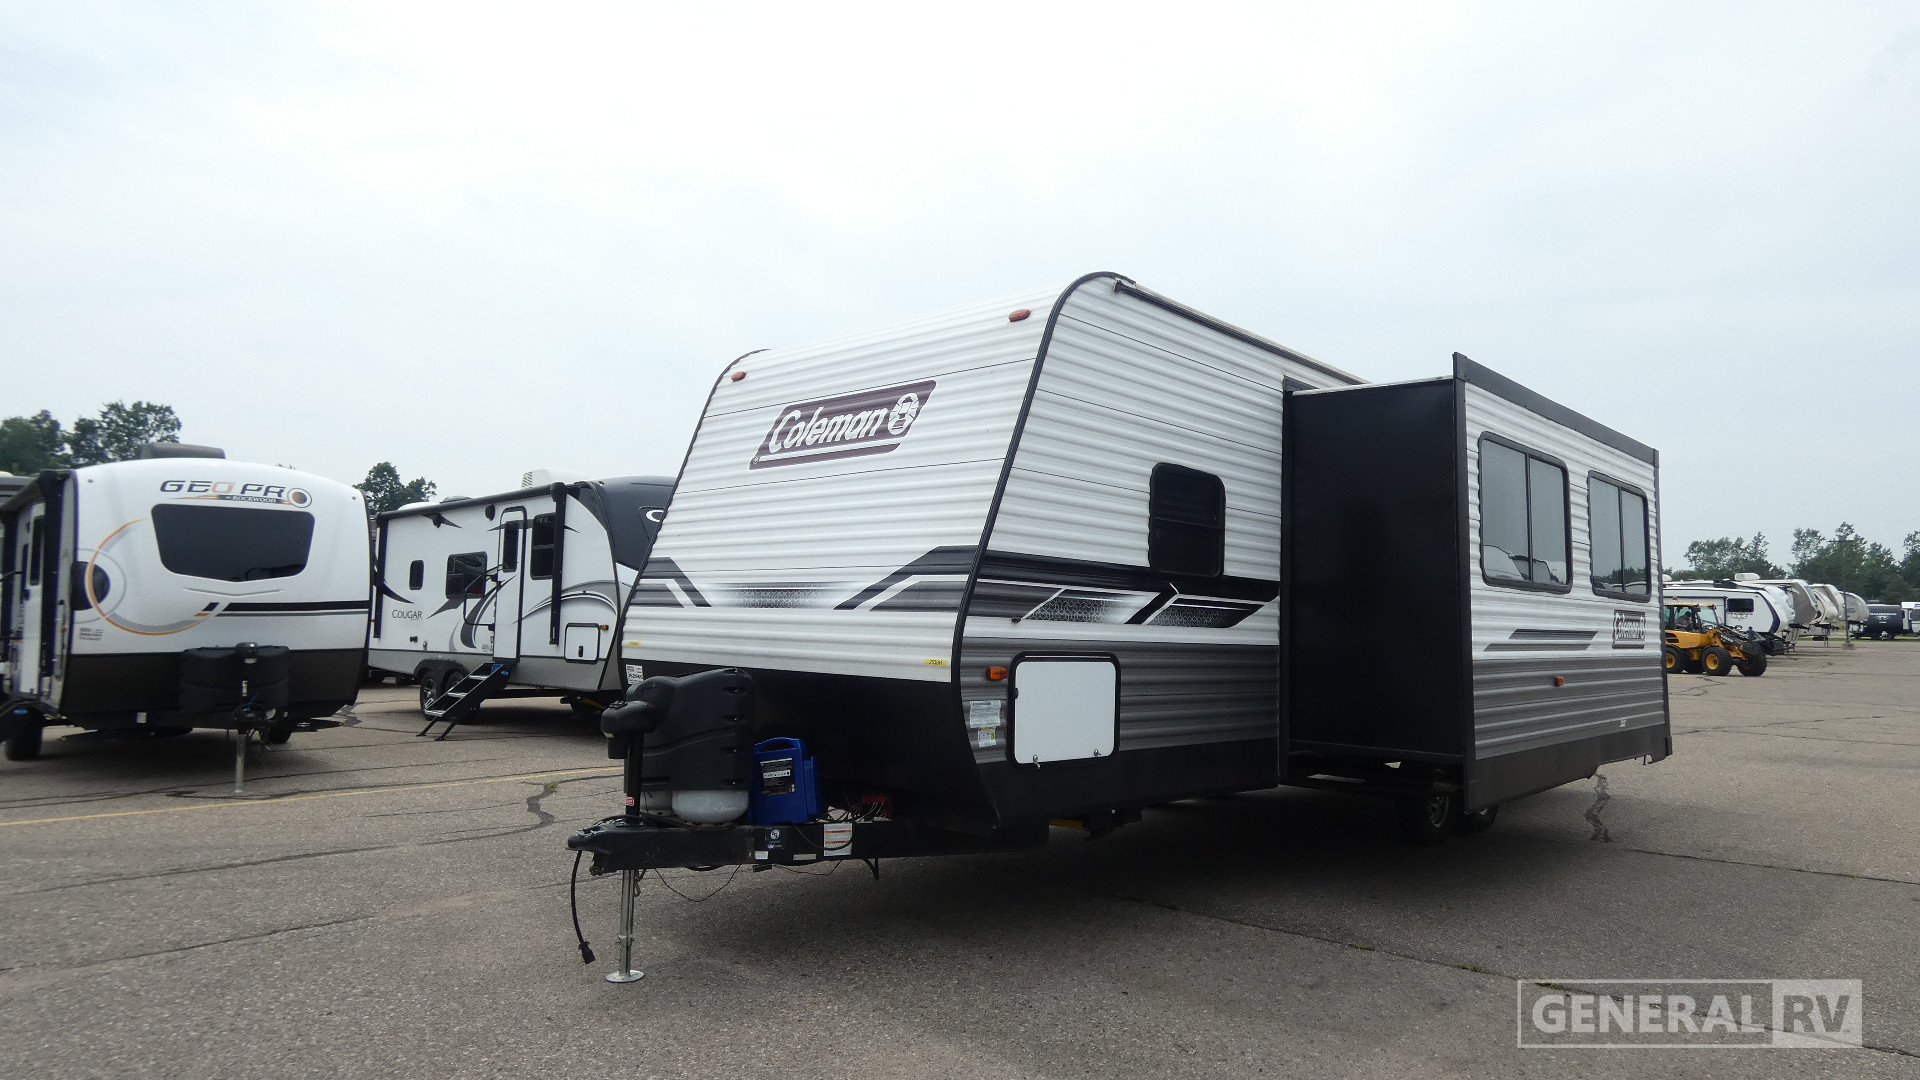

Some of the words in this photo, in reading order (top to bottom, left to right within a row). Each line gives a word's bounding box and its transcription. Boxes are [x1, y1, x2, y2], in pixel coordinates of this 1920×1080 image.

[768, 406, 889, 454] Coleman
[159, 479, 236, 494] GEO
[391, 609, 423, 619] COUGAR
